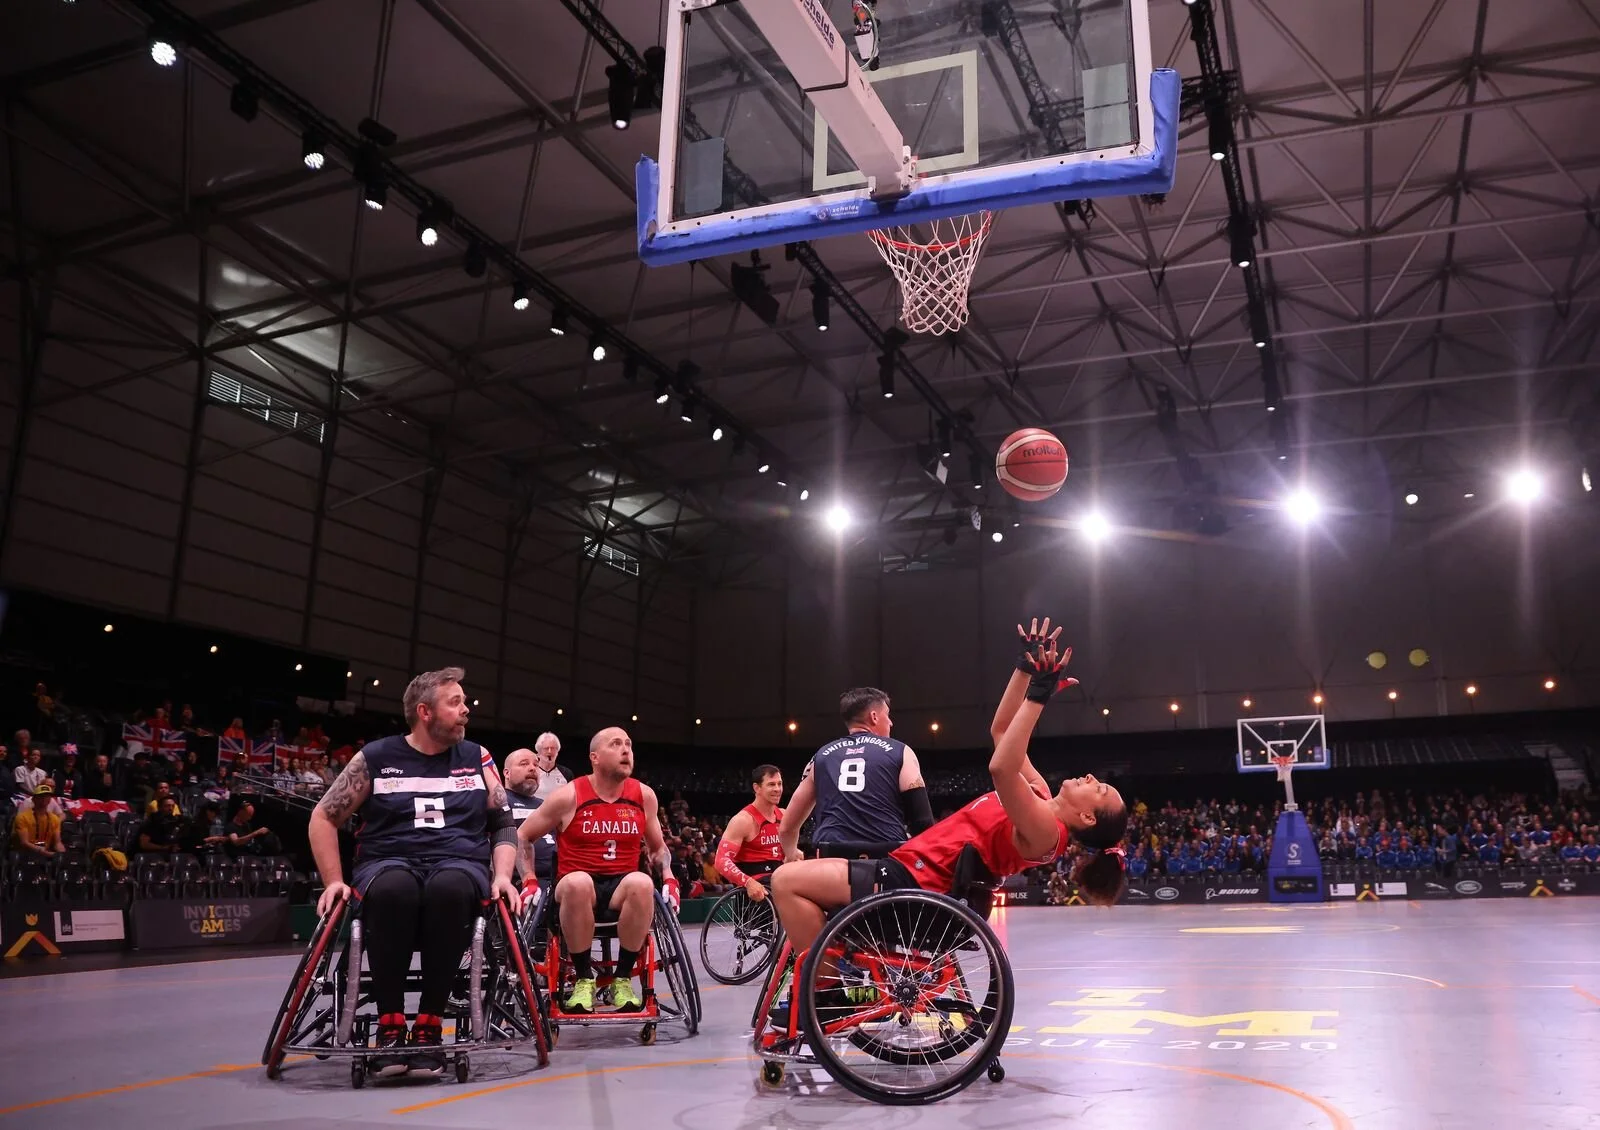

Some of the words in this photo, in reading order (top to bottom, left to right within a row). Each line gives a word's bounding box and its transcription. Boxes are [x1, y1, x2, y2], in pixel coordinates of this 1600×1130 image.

[822, 739, 854, 756] UNITED
[855, 735, 894, 752] KINGDOM
[838, 757, 866, 792] 8
[582, 820, 639, 835] CANADA
[760, 834, 780, 846] CANA
[602, 839, 617, 861] 3
[183, 905, 251, 919] INVICTUS
[189, 918, 242, 934] GAMES
[1162, 1039, 1338, 1052] 2020
